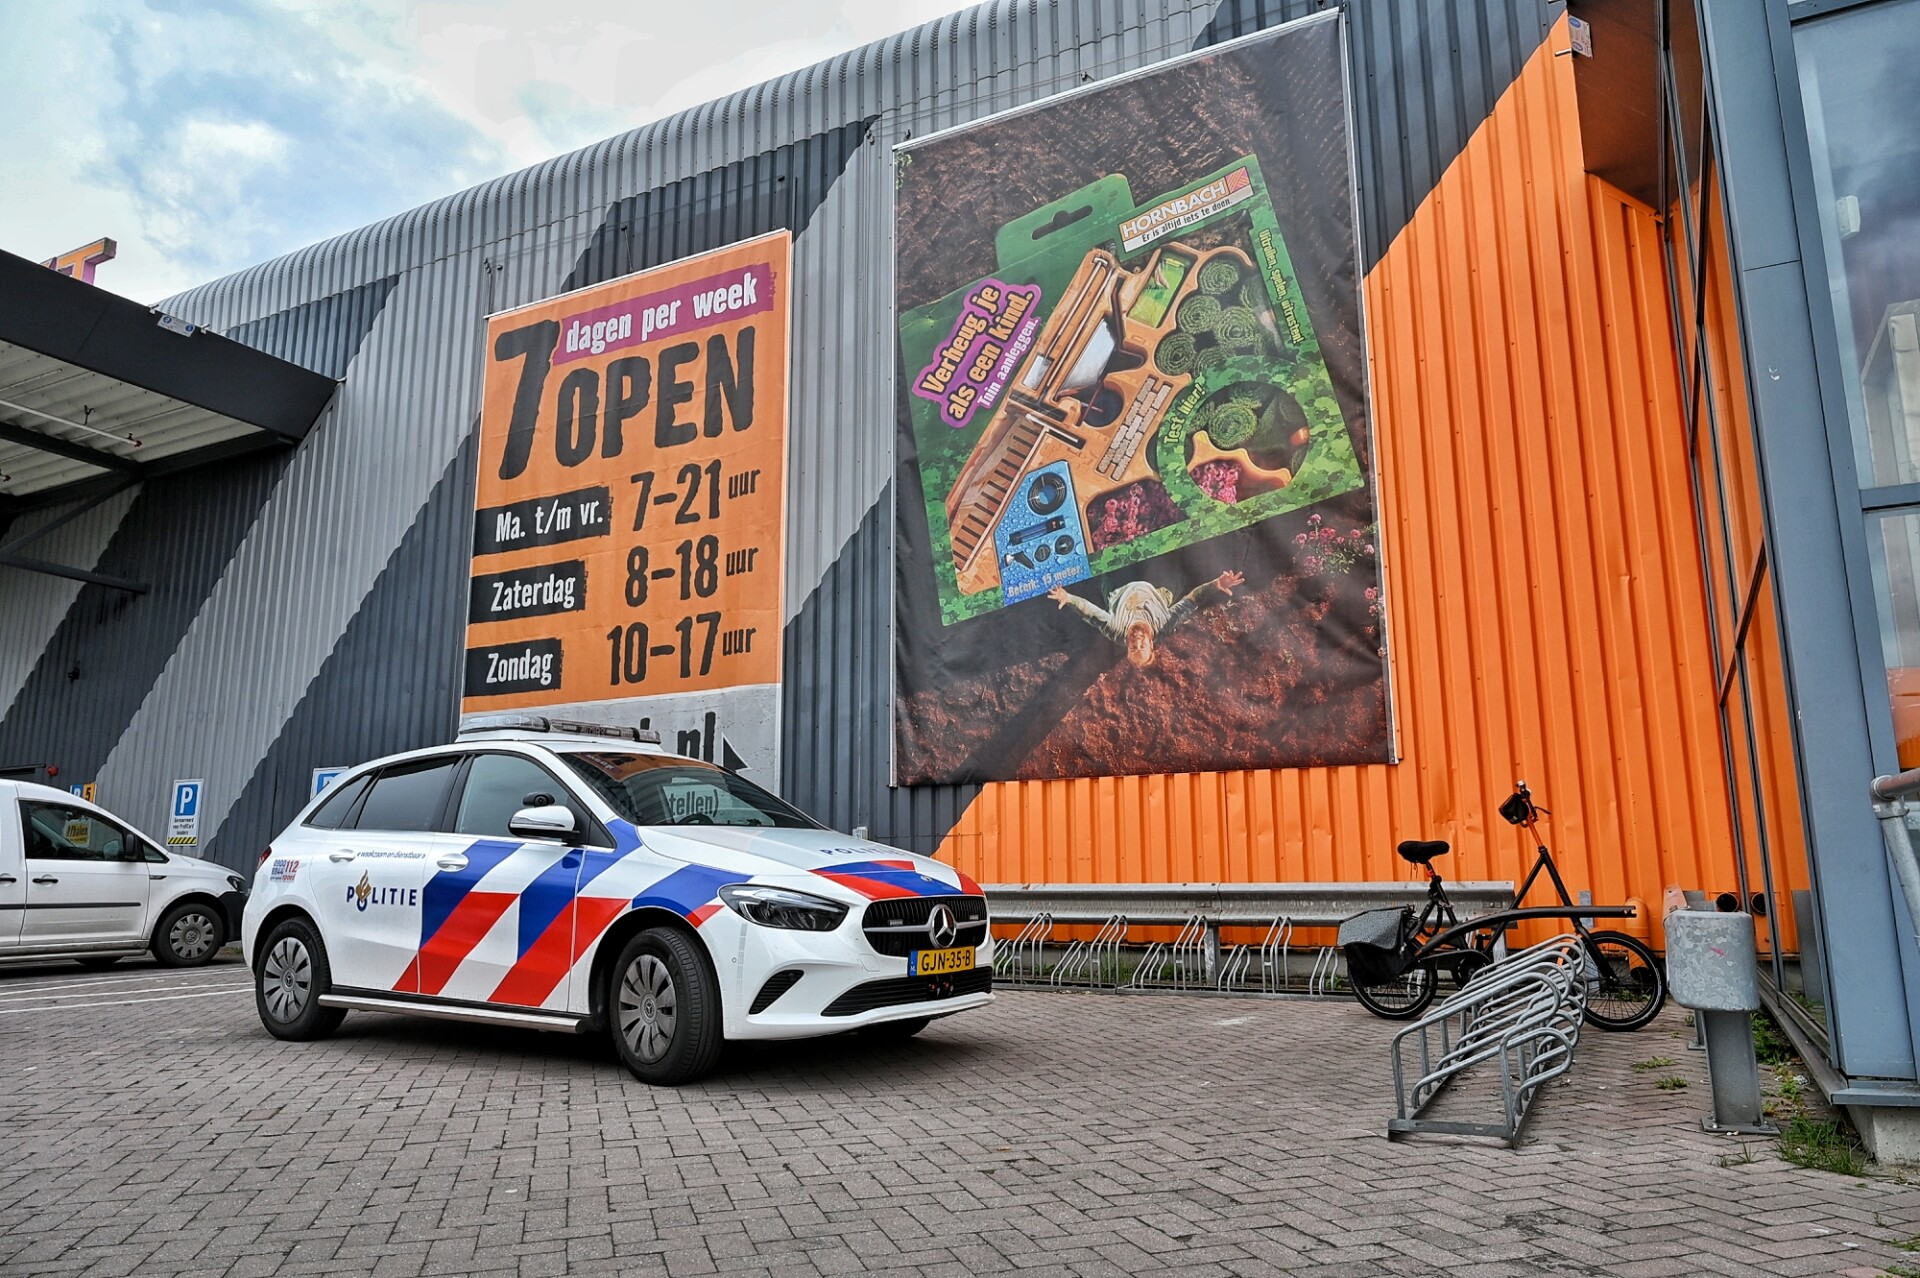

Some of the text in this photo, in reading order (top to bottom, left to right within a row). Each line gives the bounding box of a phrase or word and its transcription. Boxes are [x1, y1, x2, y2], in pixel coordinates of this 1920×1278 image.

[1122, 180, 1225, 238] HORNBACH
[1142, 233, 1152, 243] Er
[1152, 228, 1160, 238] is
[1161, 217, 1182, 233] altijd
[1183, 213, 1200, 225] iets
[1201, 207, 1211, 217] te
[566, 272, 758, 355] dagen per week
[1258, 228, 1305, 345] Uitrollen, spelen, uitrusten!
[920, 286, 1001, 394] Verheug je
[949, 292, 1034, 420] als een kind.
[977, 319, 1039, 407] Tuin aanleggen.
[494, 319, 561, 481] 7
[555, 325, 756, 469] OPEN
[1163, 382, 1206, 445] Test hier!
[495, 459, 761, 543] Ma. t/m vr. 7-21 uur
[490, 535, 759, 613] Zaterdag 8-18 uur
[1042, 573, 1053, 586] 15
[486, 610, 757, 687] Zondag 10-17 uur
[180, 786, 194, 814] P
[285, 860, 300, 873] 112
[346, 885, 418, 912] POLITIE
[921, 949, 971, 971] GJN-35-B
